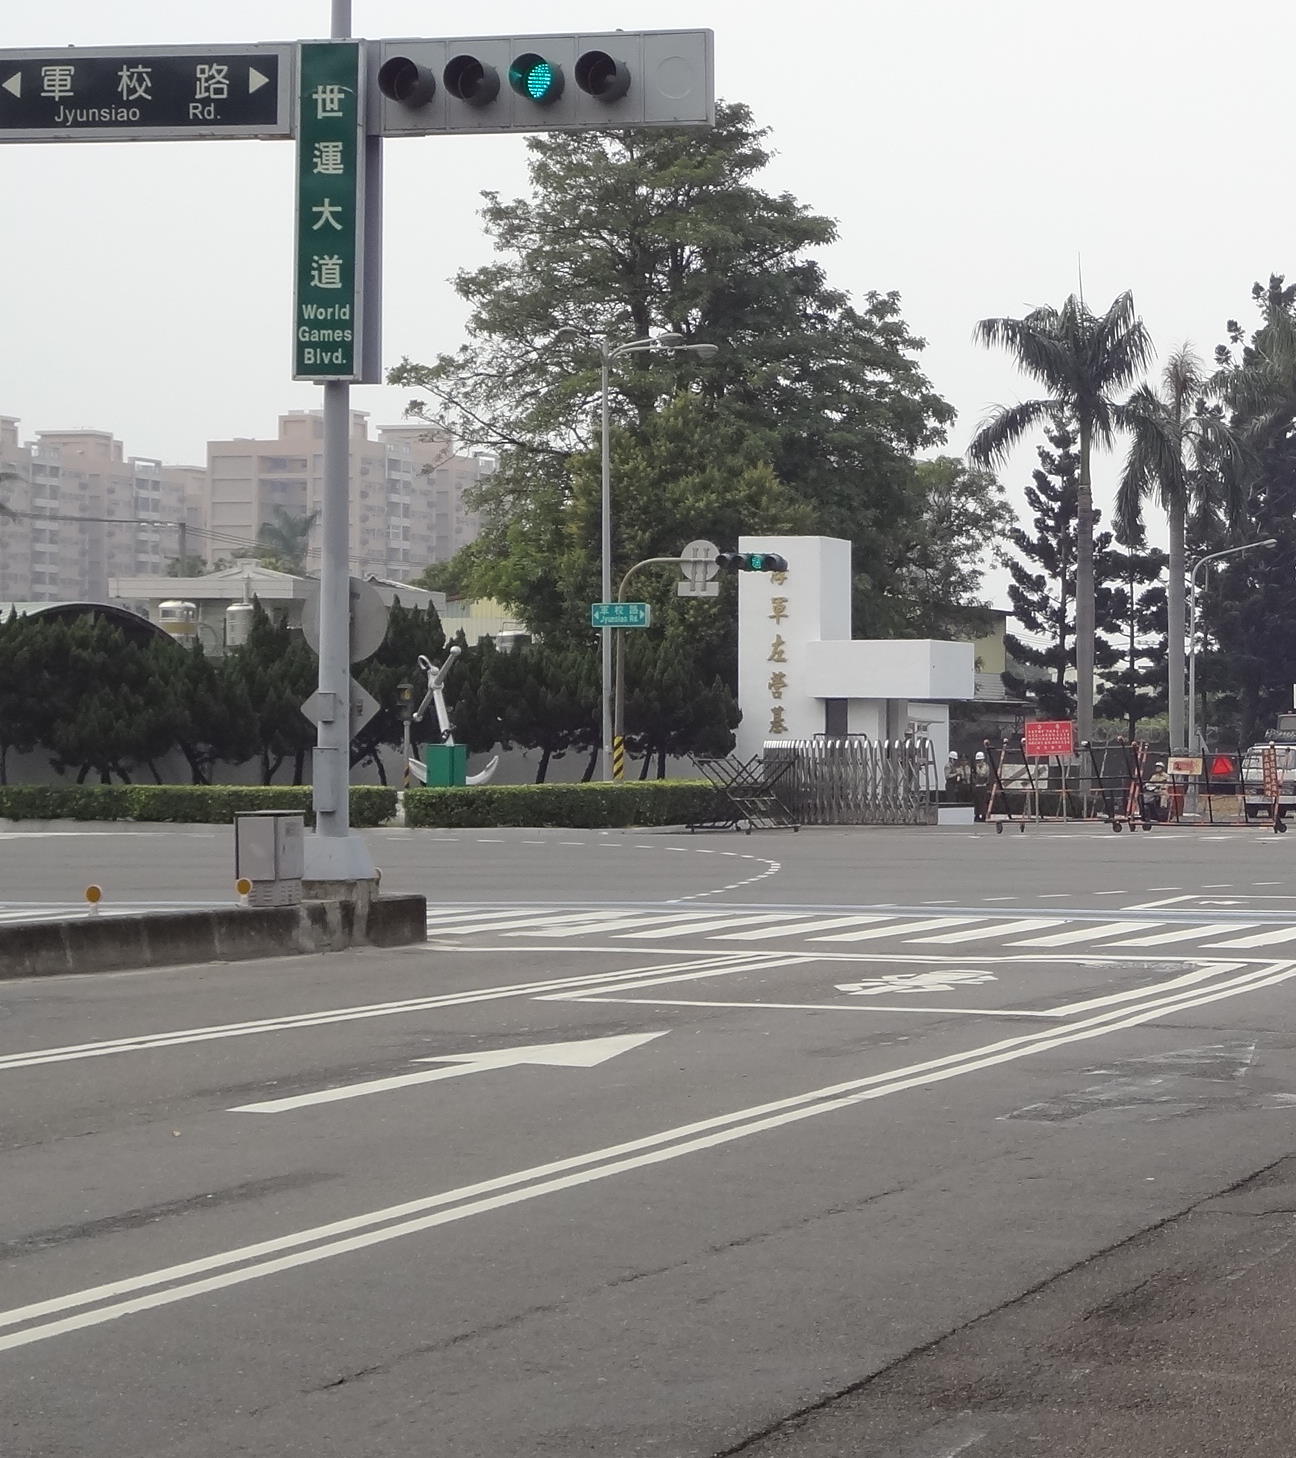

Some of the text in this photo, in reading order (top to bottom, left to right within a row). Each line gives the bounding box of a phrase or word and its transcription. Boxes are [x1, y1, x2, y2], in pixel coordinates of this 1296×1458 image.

[40, 62, 230, 102] 軍校路
[54, 103, 221, 126] Jyunsiao Rd.
[310, 84, 345, 289] 世運大道
[302, 303, 350, 320] World
[298, 326, 352, 342] Games
[303, 348, 347, 364] Blvd.
